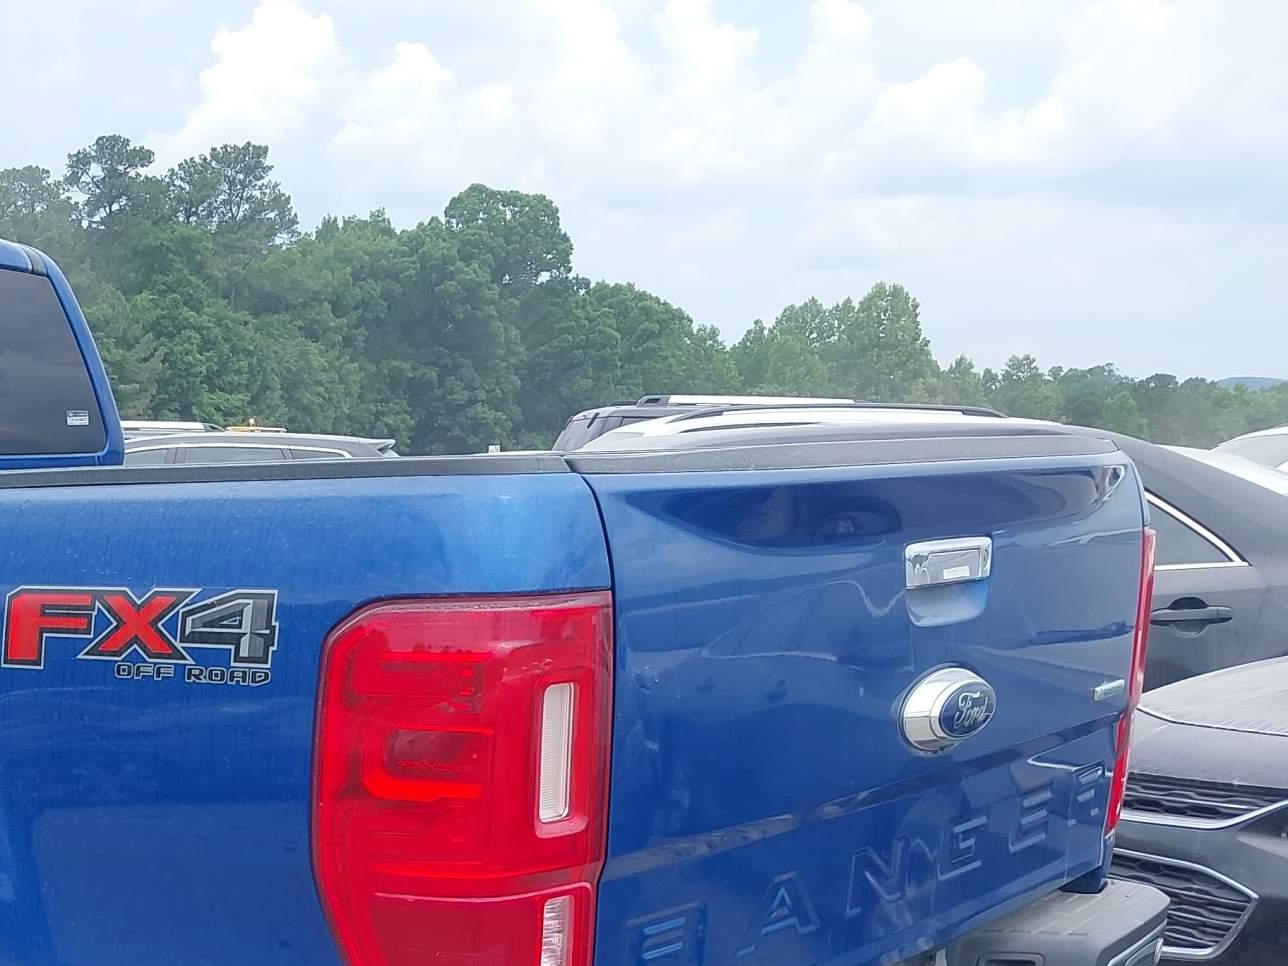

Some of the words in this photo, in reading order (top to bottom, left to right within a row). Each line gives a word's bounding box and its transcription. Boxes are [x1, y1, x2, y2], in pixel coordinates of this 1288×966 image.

[1, 585, 279, 669] FX4
[115, 662, 175, 681] OFF
[185, 665, 272, 686] ROAD
[953, 690, 993, 729] Ford
